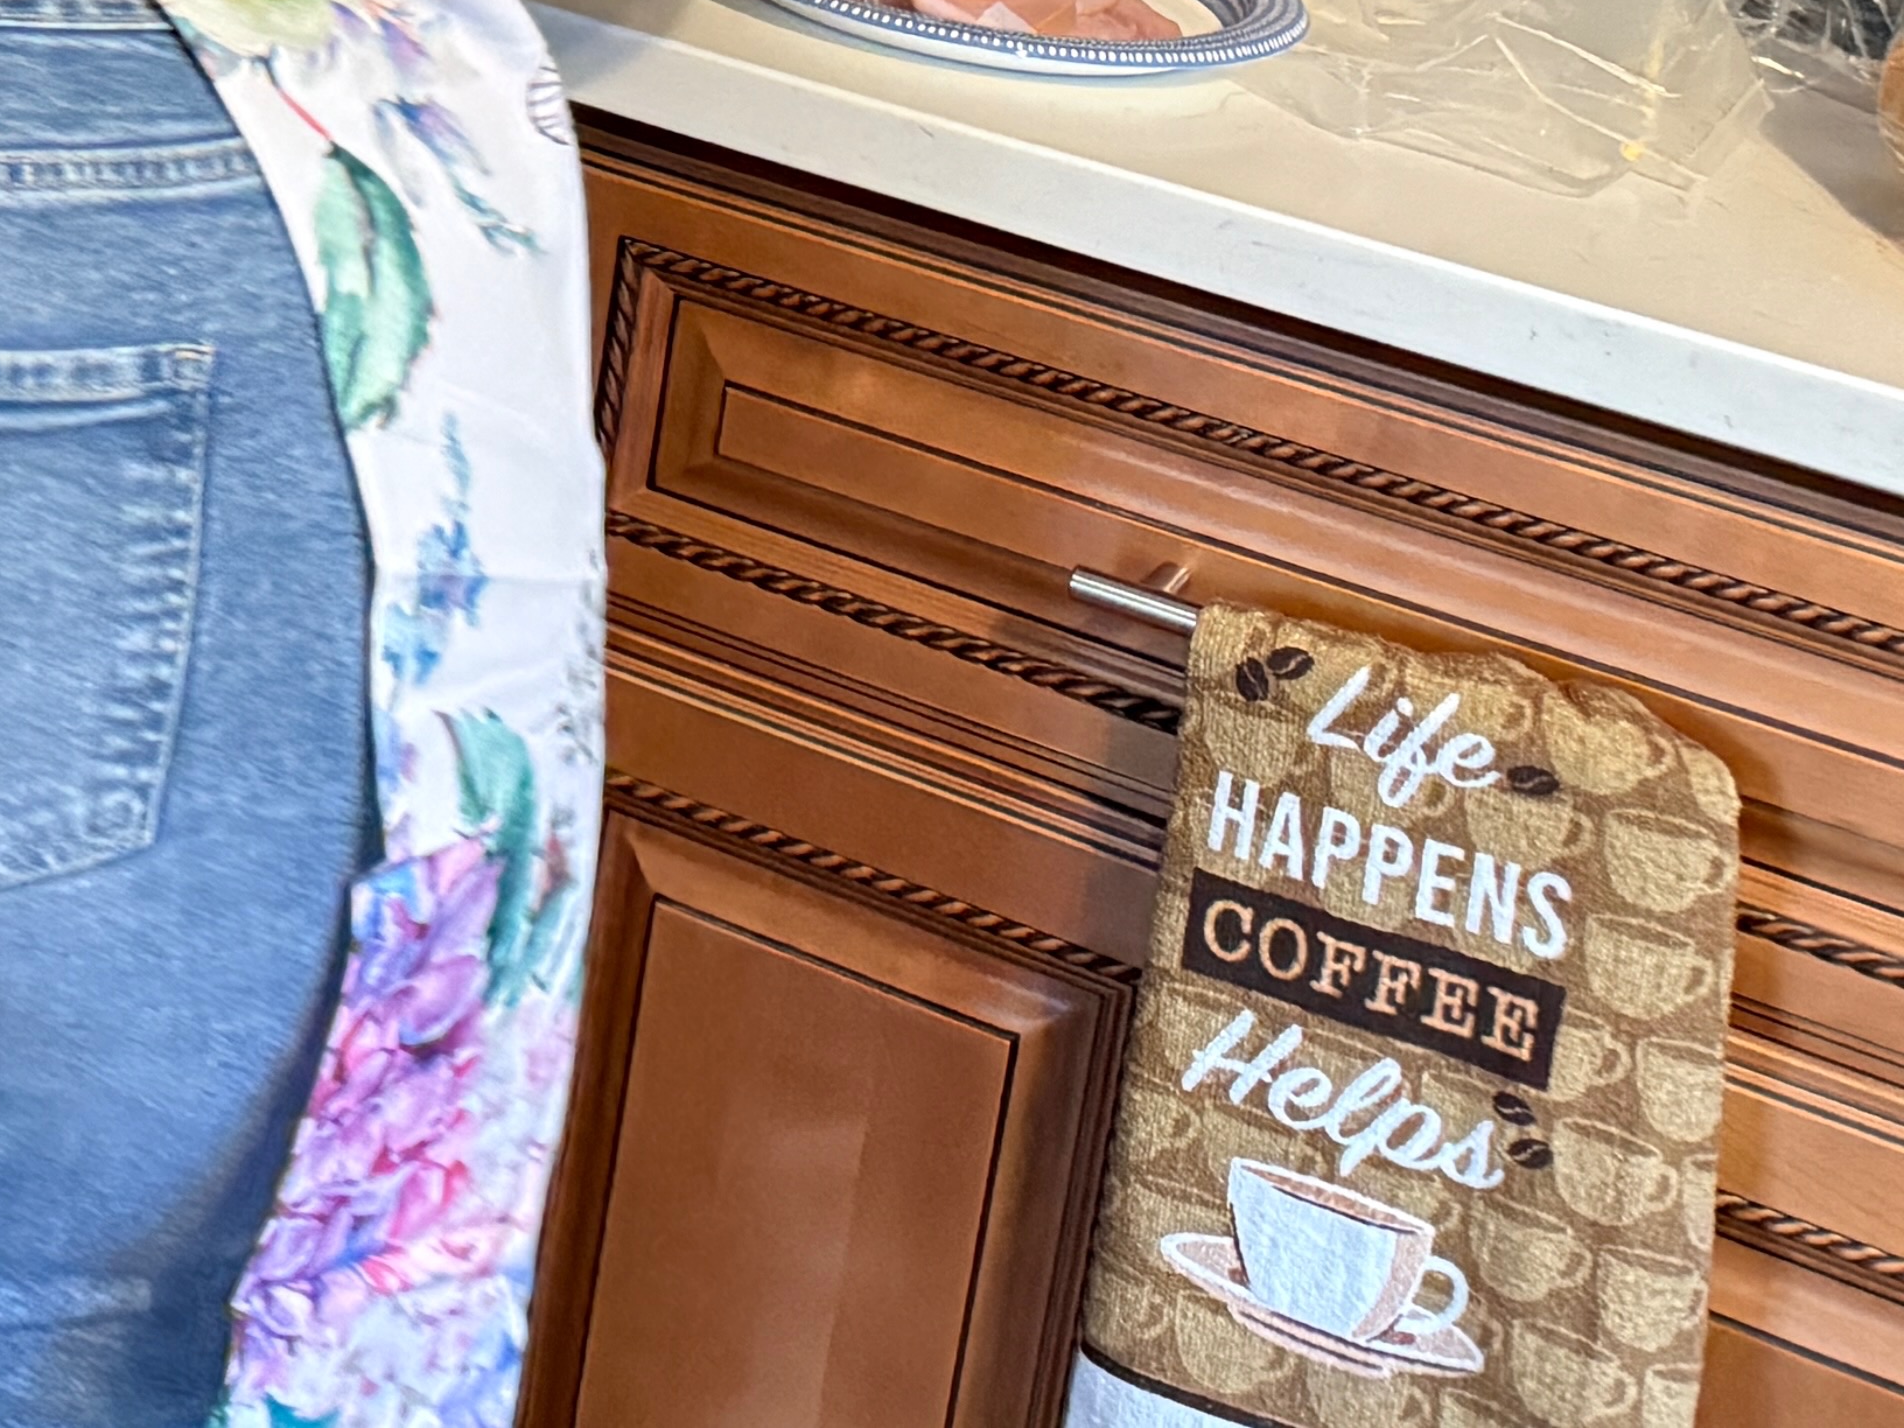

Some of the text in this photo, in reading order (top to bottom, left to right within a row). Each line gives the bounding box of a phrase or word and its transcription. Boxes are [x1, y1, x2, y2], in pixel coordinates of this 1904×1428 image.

[1307, 665, 1506, 808] Life
[1206, 771, 1573, 959] HAPPENS
[1203, 898, 1540, 1062] COFFEE
[1181, 1009, 1505, 1190] Helps
